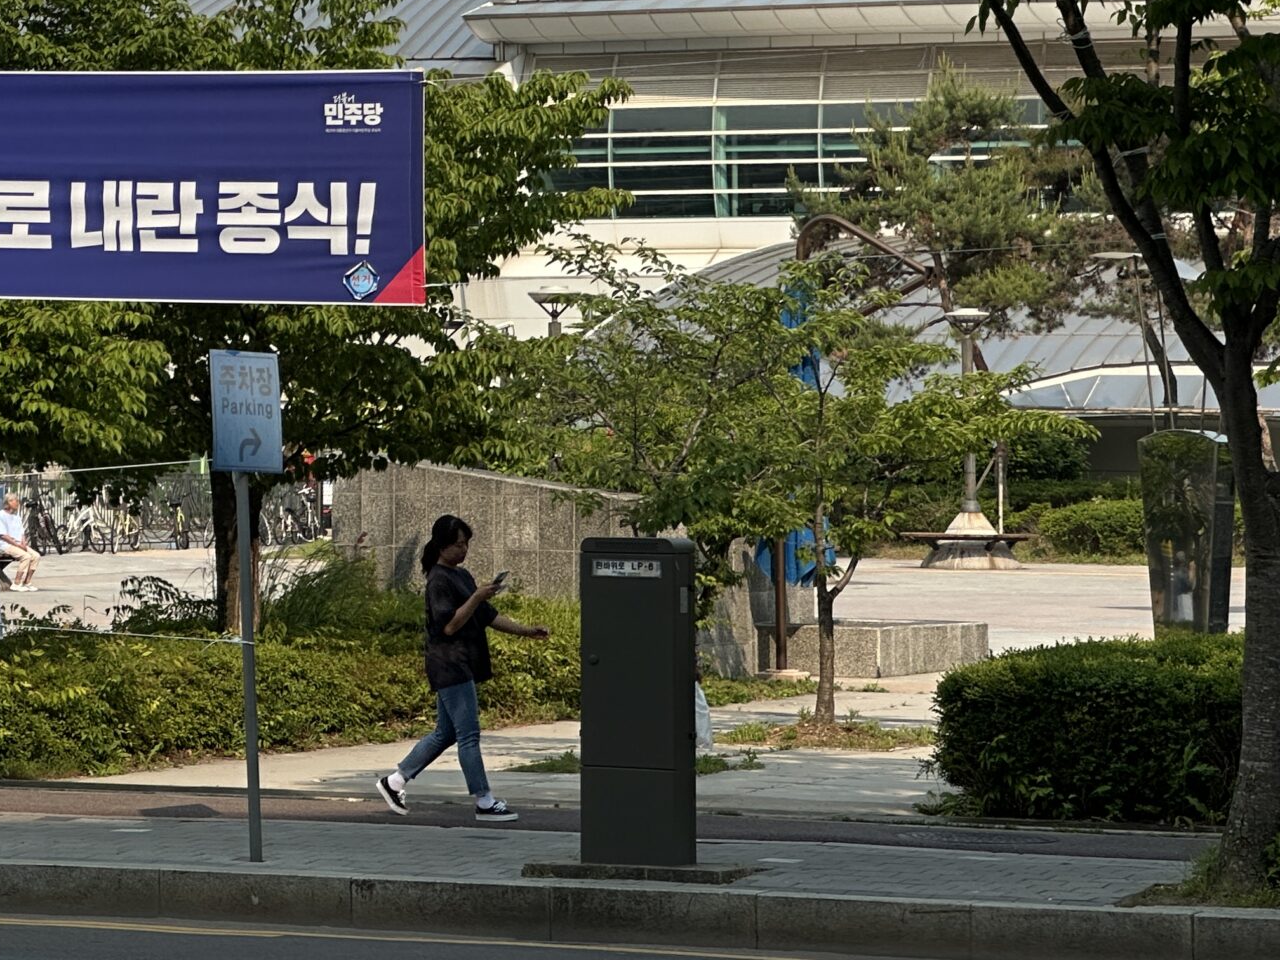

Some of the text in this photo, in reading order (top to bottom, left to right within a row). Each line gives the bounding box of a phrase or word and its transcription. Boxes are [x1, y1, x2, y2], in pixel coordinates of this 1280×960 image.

[332, 91, 356, 104] 더불어
[324, 103, 384, 126] 민주당
[69, 180, 204, 253] 내란
[217, 180, 378, 256] 종식!
[220, 364, 272, 396] 주차장
[222, 397, 273, 420] Parking
